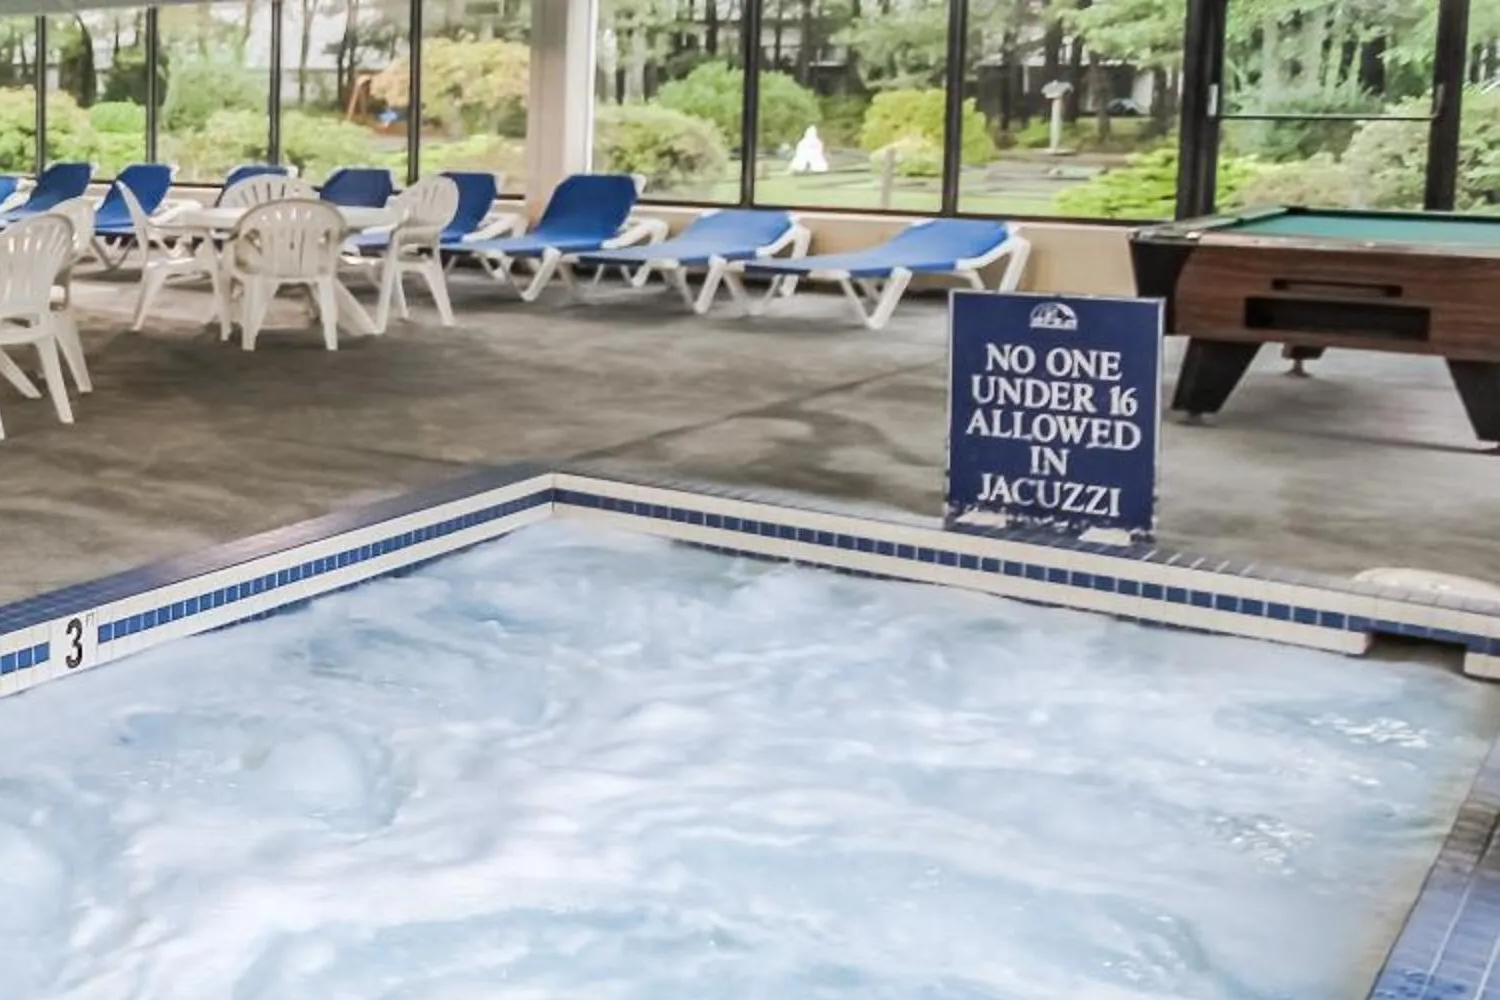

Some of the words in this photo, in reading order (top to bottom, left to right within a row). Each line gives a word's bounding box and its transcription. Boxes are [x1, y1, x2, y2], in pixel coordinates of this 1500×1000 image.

[985, 343, 1036, 374] NO
[1046, 348, 1122, 381] ONE
[971, 375, 1097, 413] UNDER
[1109, 385, 1138, 417] 16
[966, 408, 1142, 451] ALLOWED
[1030, 446, 1070, 476] IN
[977, 473, 1122, 517] JACUZZI
[65, 617, 83, 668] 3
